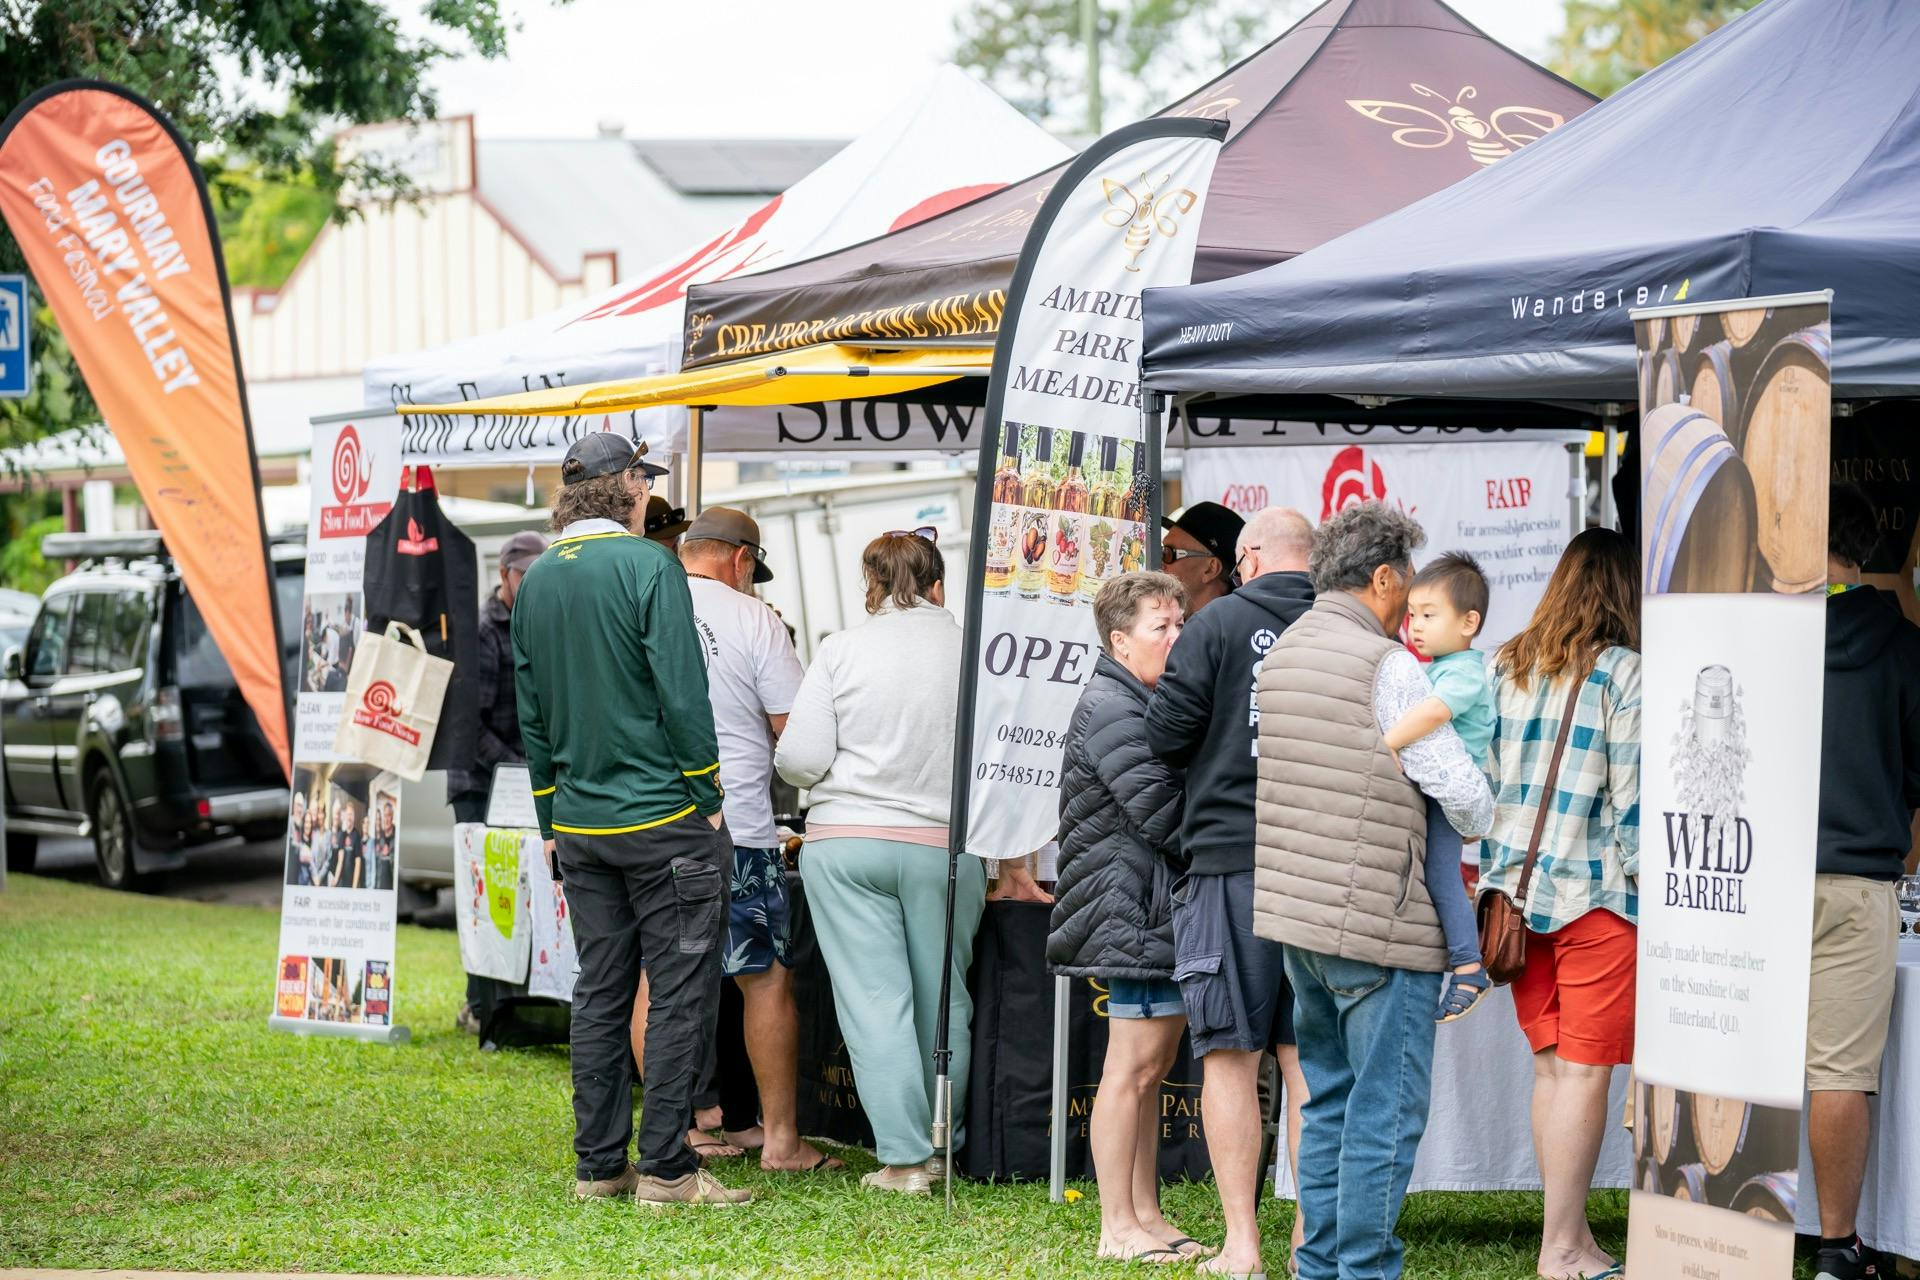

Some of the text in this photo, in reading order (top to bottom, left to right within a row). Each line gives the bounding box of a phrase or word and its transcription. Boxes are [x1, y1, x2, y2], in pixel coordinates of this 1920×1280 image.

[95, 138, 190, 281] GOURMAY
[66, 178, 200, 395] MARY VALLEY
[1511, 284, 1668, 320] Wanderer
[1052, 329, 1136, 364] PARK
[1178, 322, 1234, 345] HEAVY DUTY
[1222, 484, 1269, 513] GOOD
[701, 622, 717, 645] PARK
[711, 647, 719, 657] IT
[985, 632, 1104, 687] OPE
[1663, 811, 1753, 874] WILD
[1665, 872, 1746, 914] BARREL
[1646, 939, 1674, 964] Locally
[1675, 943, 1700, 963] made
[1702, 944, 1728, 966] barrel
[1659, 974, 1750, 1003] on the Sunshine Coast
